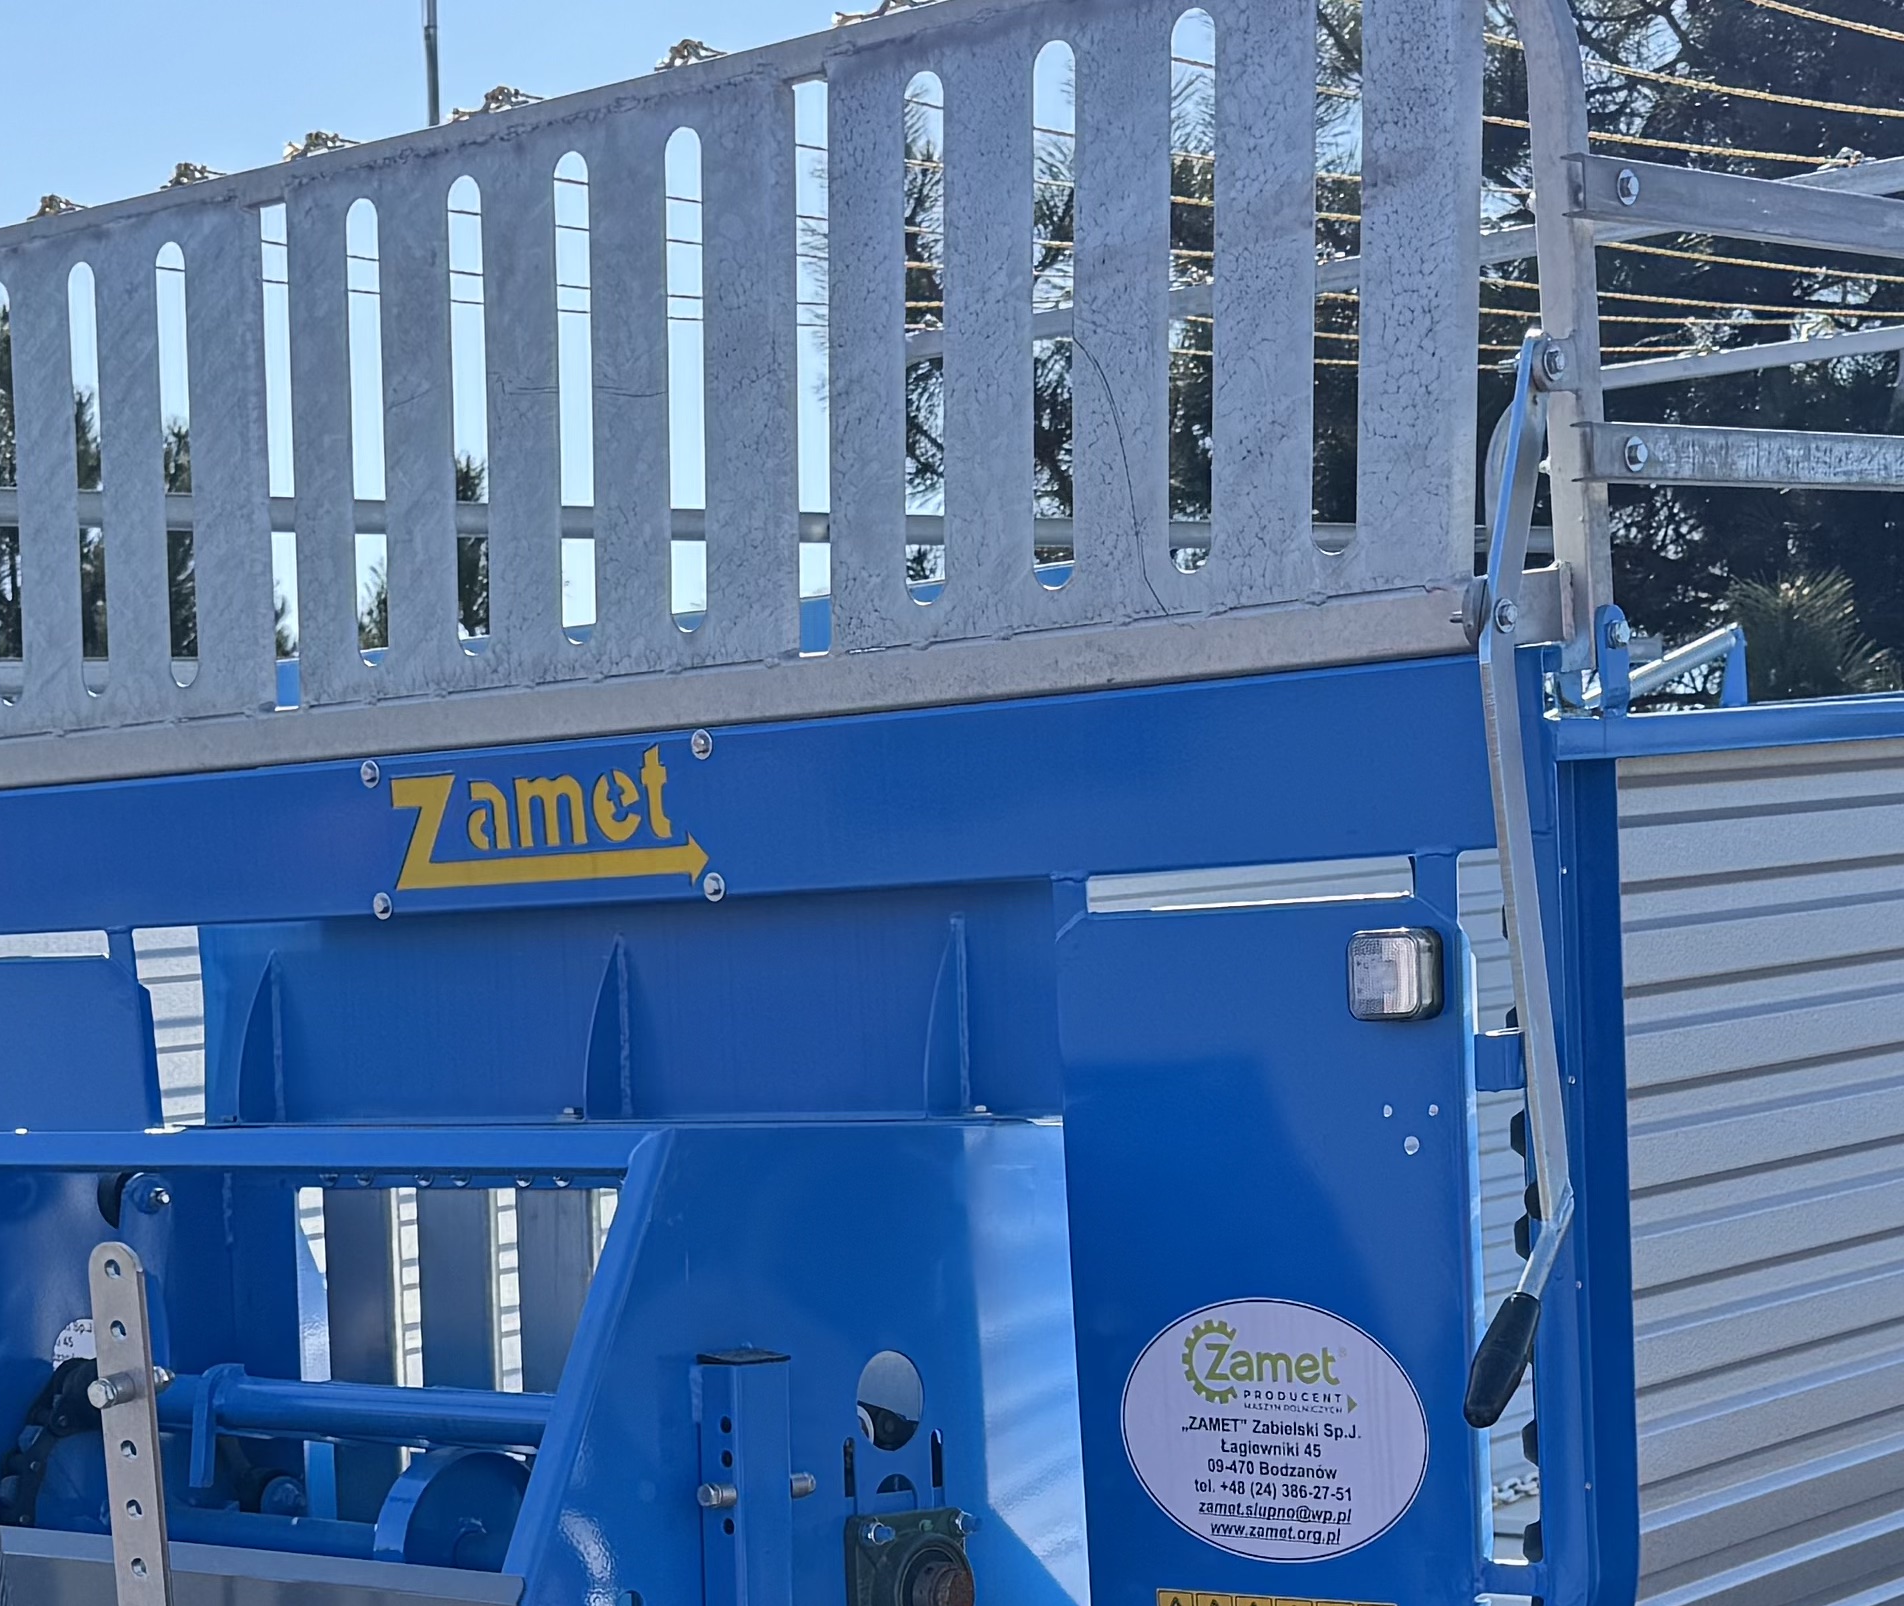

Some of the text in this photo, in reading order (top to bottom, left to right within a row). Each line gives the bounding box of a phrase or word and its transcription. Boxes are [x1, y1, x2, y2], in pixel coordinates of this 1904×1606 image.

[390, 743, 709, 890] Zamet
[1204, 1343, 1341, 1386] Zamet
[1243, 1390, 1343, 1404] PRODUCENT
[1252, 1419, 1319, 1437] Zabielski
[1324, 1423, 1361, 1440] Sp.J.
[1304, 1443, 1321, 1458] 45
[1207, 1458, 1337, 1480] 09-470 Bodzanów
[1194, 1479, 1352, 1501] tel. +48 (24) 386-27-51
[1210, 1523, 1341, 1545] www.zamet.org.pl
